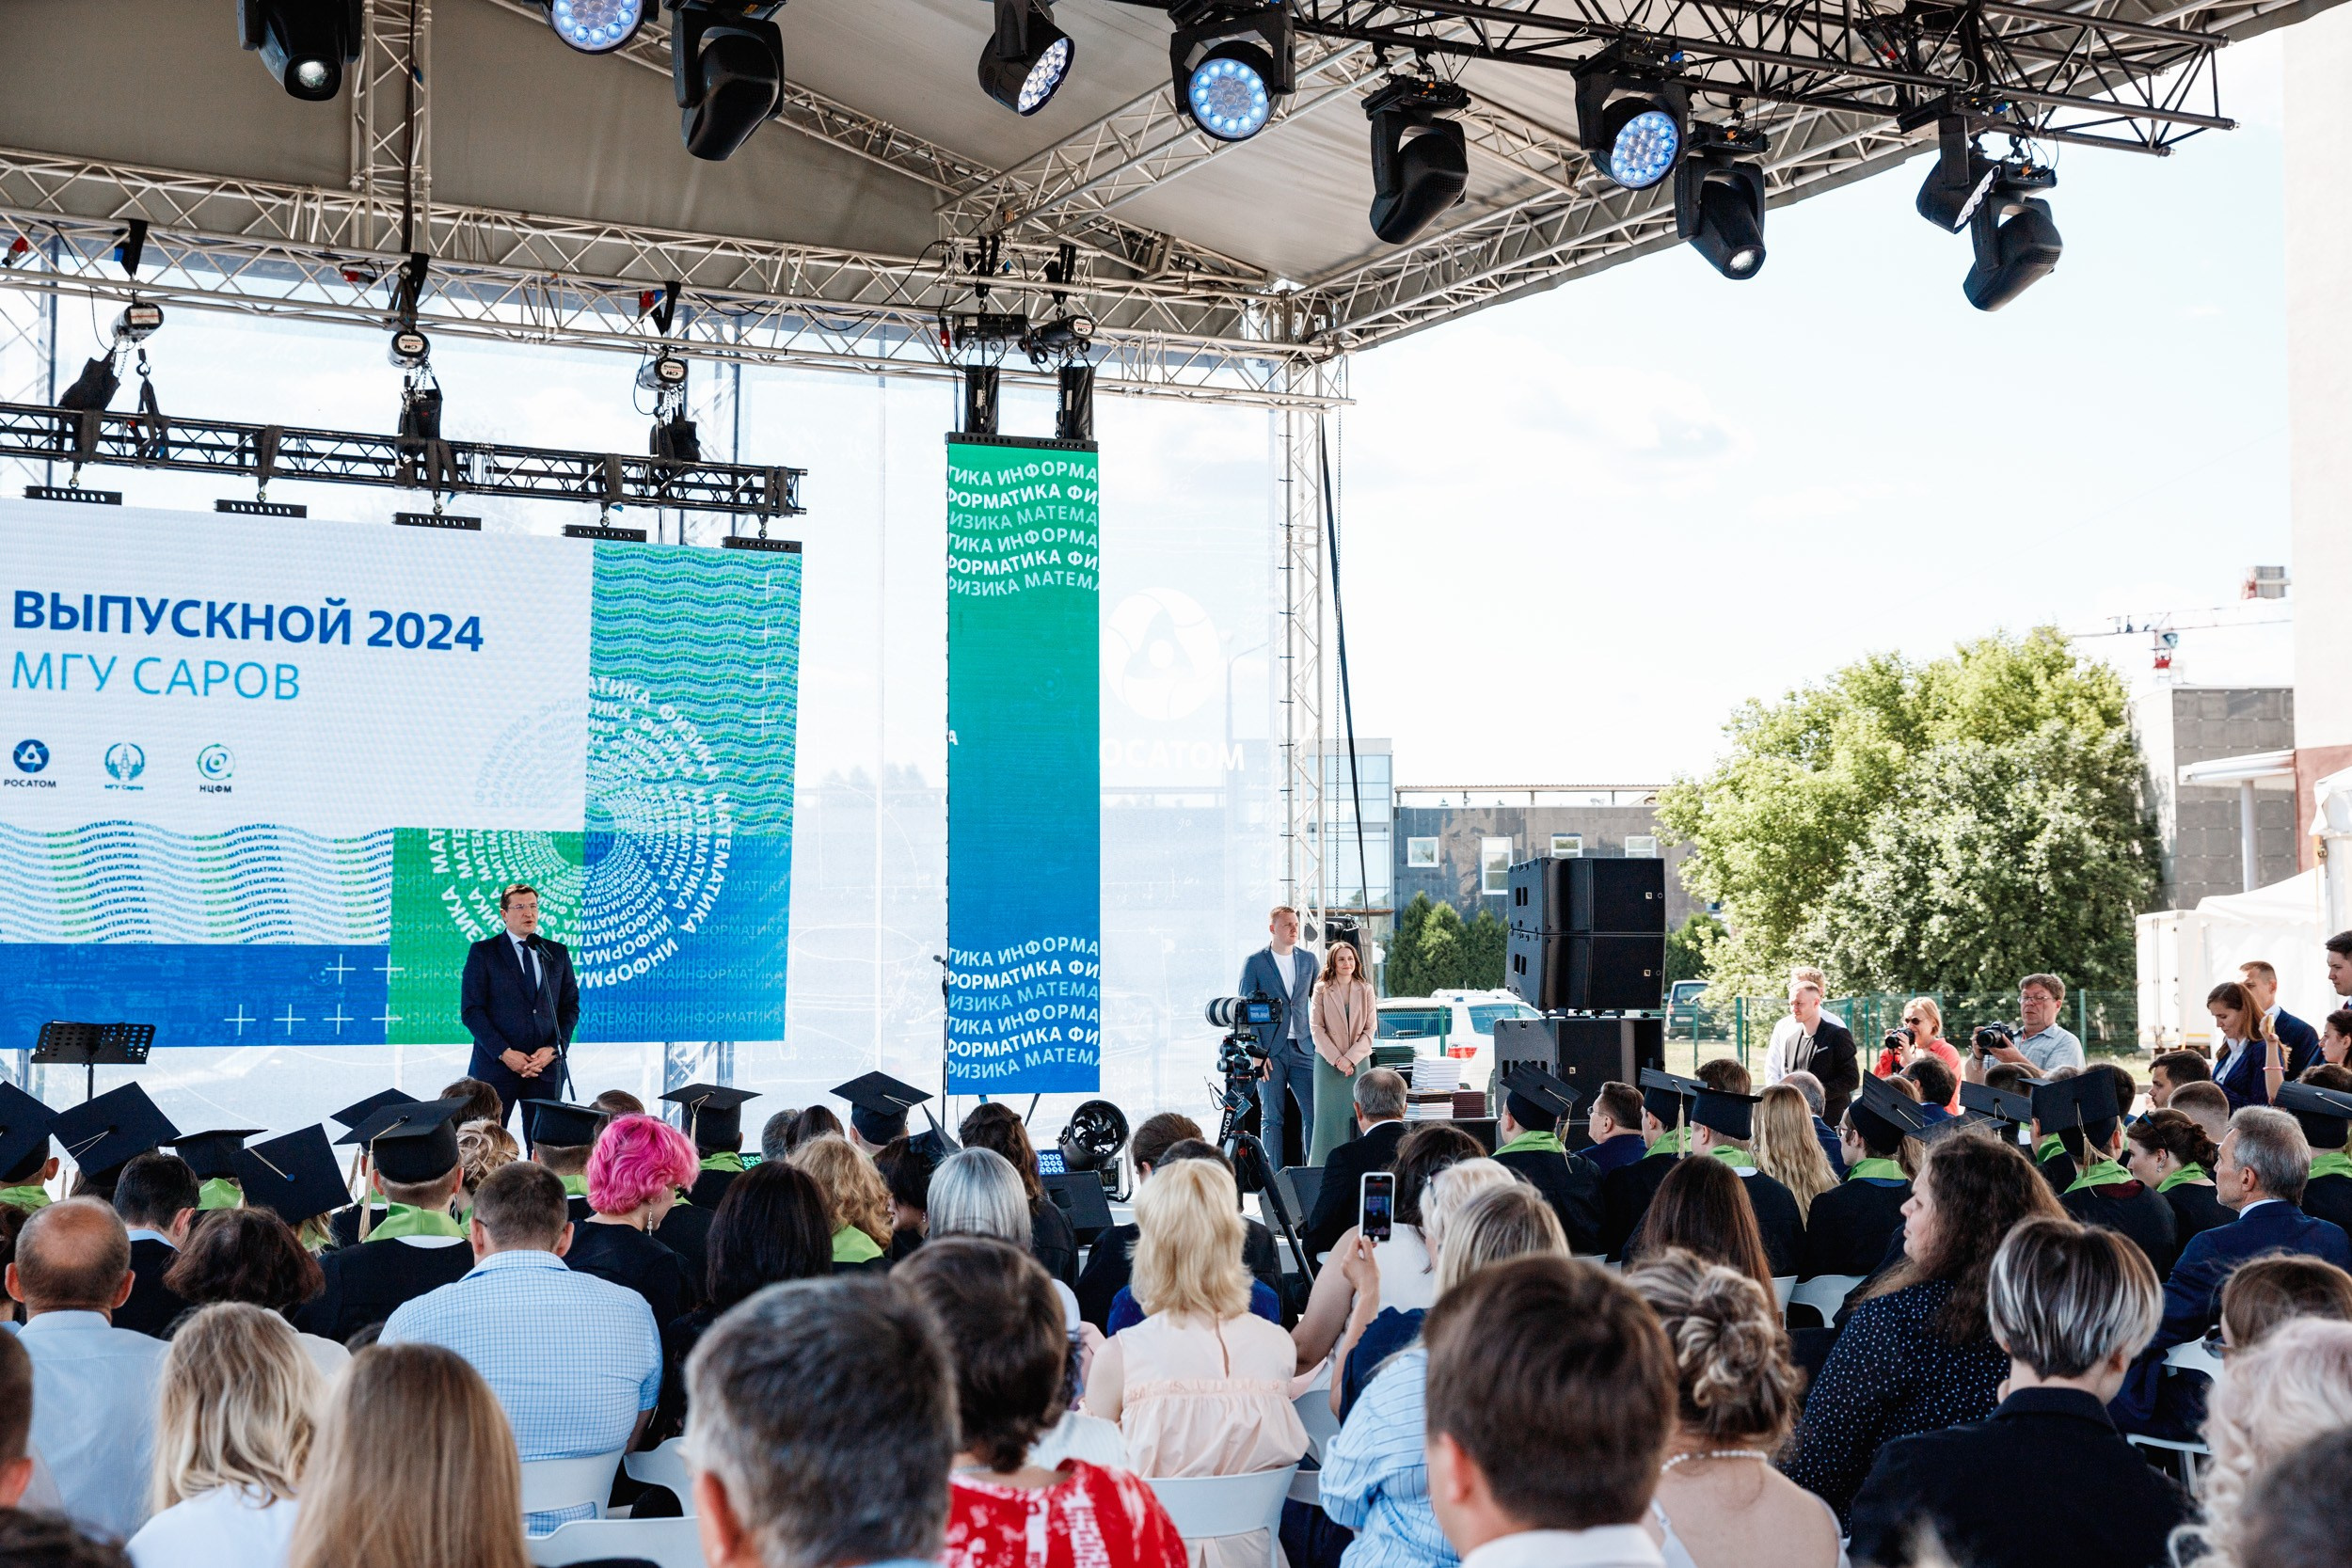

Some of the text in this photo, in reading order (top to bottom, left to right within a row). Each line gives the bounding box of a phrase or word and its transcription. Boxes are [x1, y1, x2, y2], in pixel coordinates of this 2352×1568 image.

[997, 461, 1097, 485] ИНФОРМА
[1067, 485, 1099, 506] ФИ
[948, 511, 1012, 531] ИЗИКА
[997, 528, 1097, 553] ИНФОРМА
[1067, 550, 1099, 571] ФИ
[14, 590, 484, 652] ВЫПУСКНОЙ 2024
[11, 651, 300, 701] МГУ САРОВ
[1100, 737, 1245, 771] ОСАТОМ
[4, 779, 56, 788] РОСАТОМ
[199, 784, 232, 793] НЦФМ
[78, 820, 134, 833] МАТЕМАТИКА
[224, 824, 277, 837] МАТЕМАТИКА
[80, 832, 135, 844] МАТЕМАТИКА
[226, 834, 278, 847] МАТЕМАТИКА
[82, 842, 137, 855] МАТЕМАТИКА
[228, 845, 280, 858] МАТЕМАТИКА
[672, 787, 710, 911] МАТЕМАТИКА
[84, 853, 139, 865] МАТЕМАТИКА
[230, 856, 282, 869] МАТЕМАТИКА
[86, 863, 141, 877] МАТЕМАТИКА
[231, 866, 284, 879] МАТЕМАТИКА
[679, 792, 732, 934] МАТЕМАТИКА
[87, 875, 143, 888] МАТЕМАТИКА
[233, 877, 286, 890] МАТЕМАТИКА
[572, 868, 656, 916] ИНФОРМАТИКА
[89, 886, 145, 898] МАТЕМАТИКА
[235, 888, 287, 901] МАТЕМАТИКА
[91, 896, 147, 910] МАТЕМАТИКА
[237, 898, 289, 911] МАТЕМАТИКА
[93, 908, 149, 920] МАТЕМАТИКА
[239, 910, 291, 922] МАТЕМАТИКА
[562, 881, 662, 930] ИНФОРМАТИКА
[95, 918, 151, 931] МАТЕМАТИКА
[241, 920, 293, 933] МАТЕМАТИКА
[97, 929, 294, 943] МАТЕМАТИКА МАТЕМАТИКА
[997, 937, 1098, 965] ИНФОРМА
[1068, 959, 1100, 980] ФИ
[949, 981, 1098, 1012] ИЗИКА МАТЕМА
[997, 1004, 1098, 1033] ИНФОРМА
[1068, 1026, 1100, 1047] ФИ
[1221, 1113, 1232, 1140] SONY
